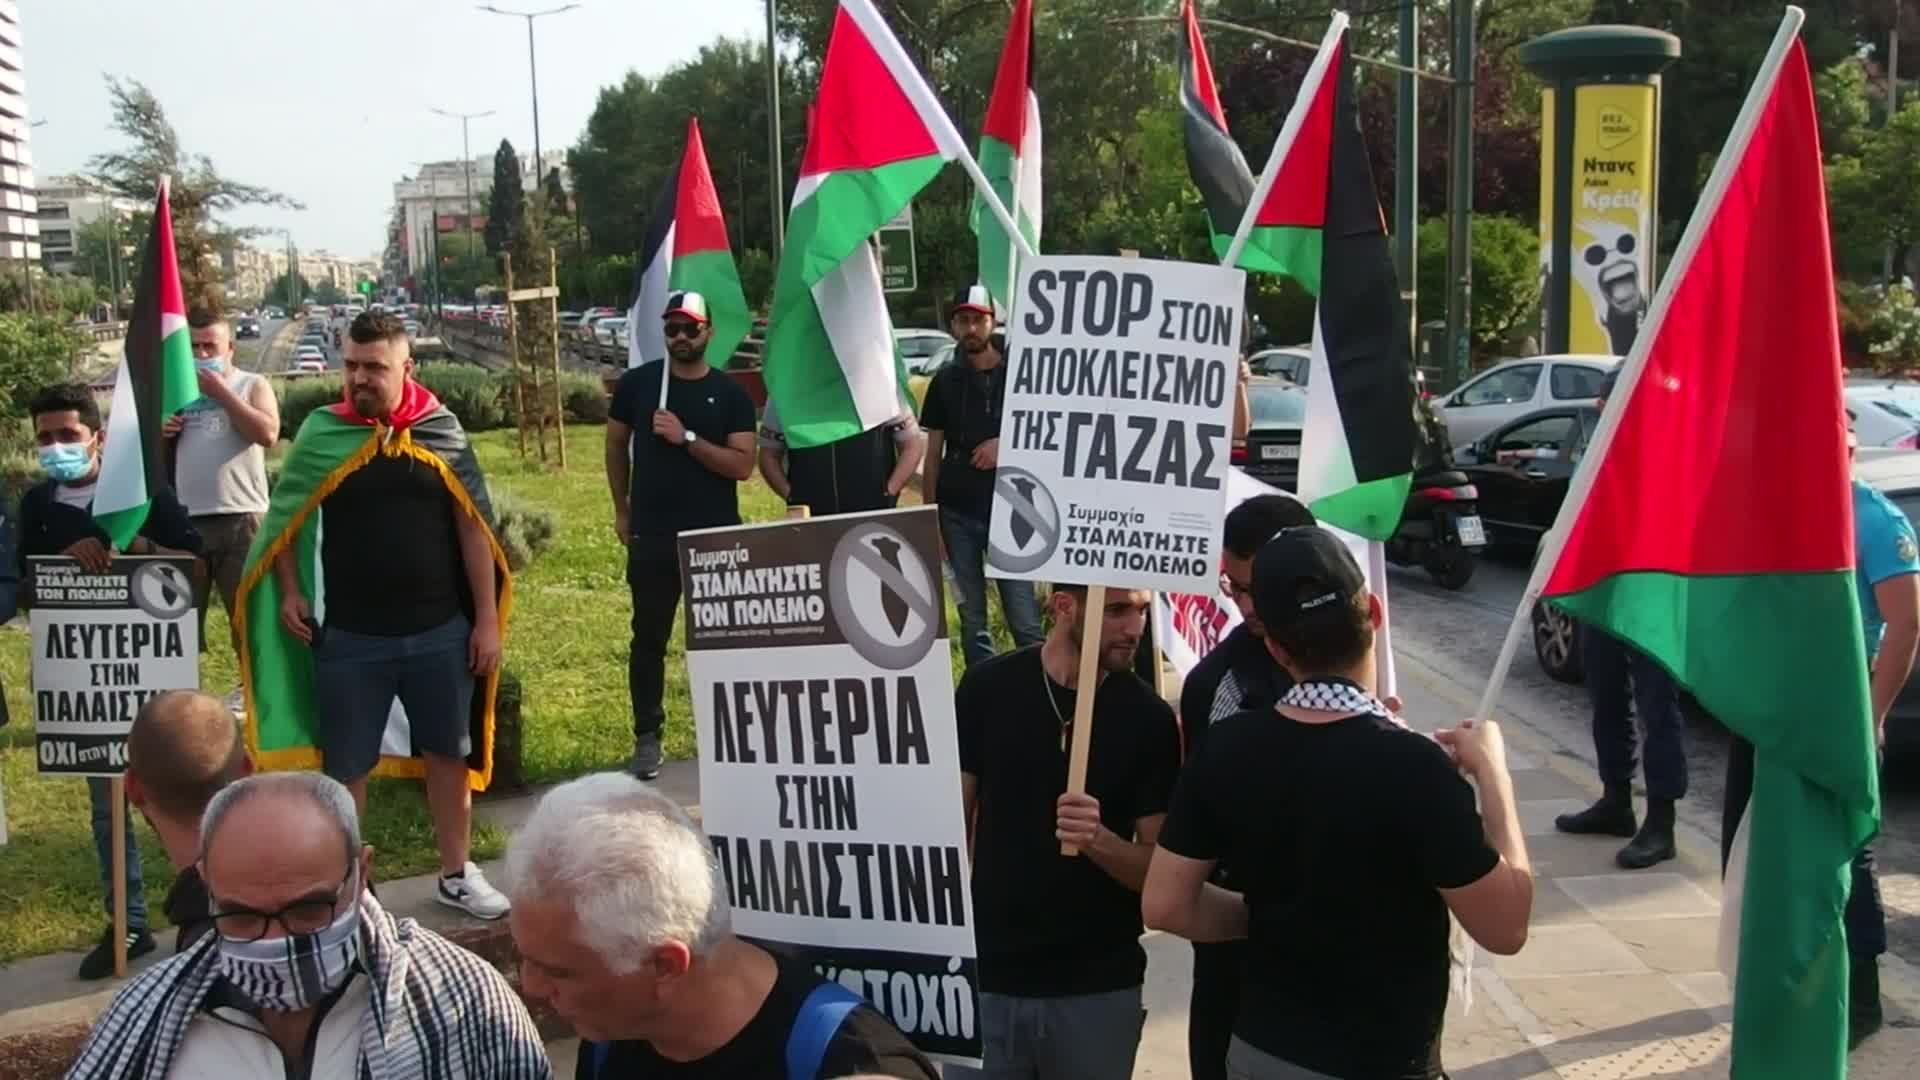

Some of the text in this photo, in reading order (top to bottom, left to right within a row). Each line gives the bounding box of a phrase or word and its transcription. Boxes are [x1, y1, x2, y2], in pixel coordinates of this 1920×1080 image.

[1024, 269, 1233, 347] STOP ΣΤΟΝ
[1013, 347, 1226, 409] ΑΠΟΚΛΕΙΣΜΟ
[1011, 410, 1226, 490] ΤΗΣ ΓΑΖΑΣ
[1067, 503, 1145, 527] Συμμαχία
[689, 542, 749, 570] Συμμαχία
[1065, 525, 1209, 555] ΣΤΑΜΑΤΗΣΤΕ
[1064, 547, 1207, 577] ΤΟΝ ΠΟΛΕΜΟ
[36, 588, 128, 600] ΤΟΝ ΠΟΛΕΜΟ
[691, 563, 823, 599] ΣΤΑΜΑΤΗΣΤΕ
[692, 595, 825, 628] ΤΟΝ ΠΟΛΕΜΟ
[46, 622, 183, 660] ΛΕΥΤΕΡΙΑ
[90, 663, 140, 686] ΣΤΗΝ
[37, 689, 168, 723] ΠΑΛΑΙΣΤ
[713, 676, 930, 765] ΛΕΥΤΕΡΙΑ
[40, 741, 77, 766] ΟΧΙ
[776, 774, 857, 831] ΣΤΗΝ
